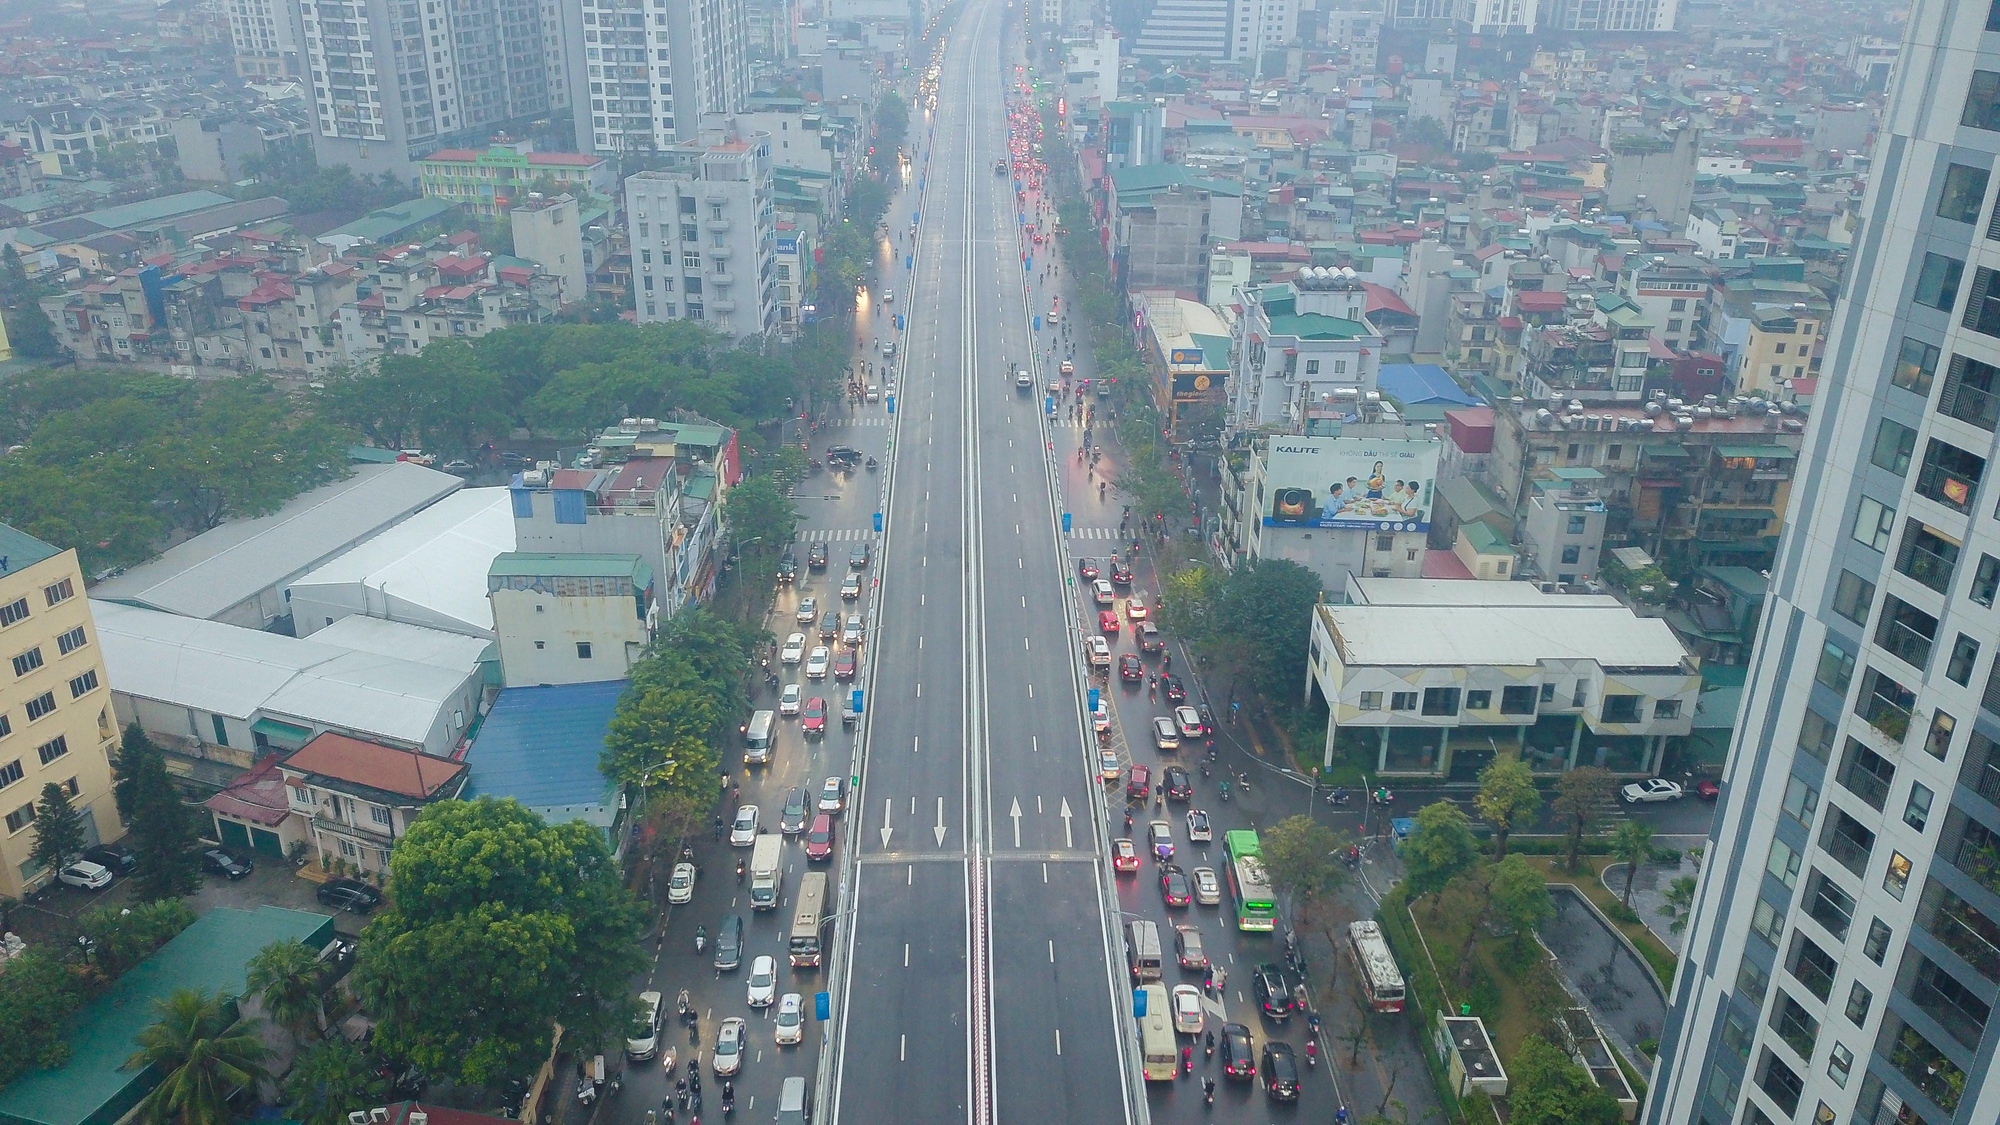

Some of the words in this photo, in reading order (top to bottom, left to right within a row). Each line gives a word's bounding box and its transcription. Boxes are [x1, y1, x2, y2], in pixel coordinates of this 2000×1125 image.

[778, 243, 794, 251] ank
[1276, 446, 1320, 454] KALITE
[1339, 449, 1362, 457] KHÔNG
